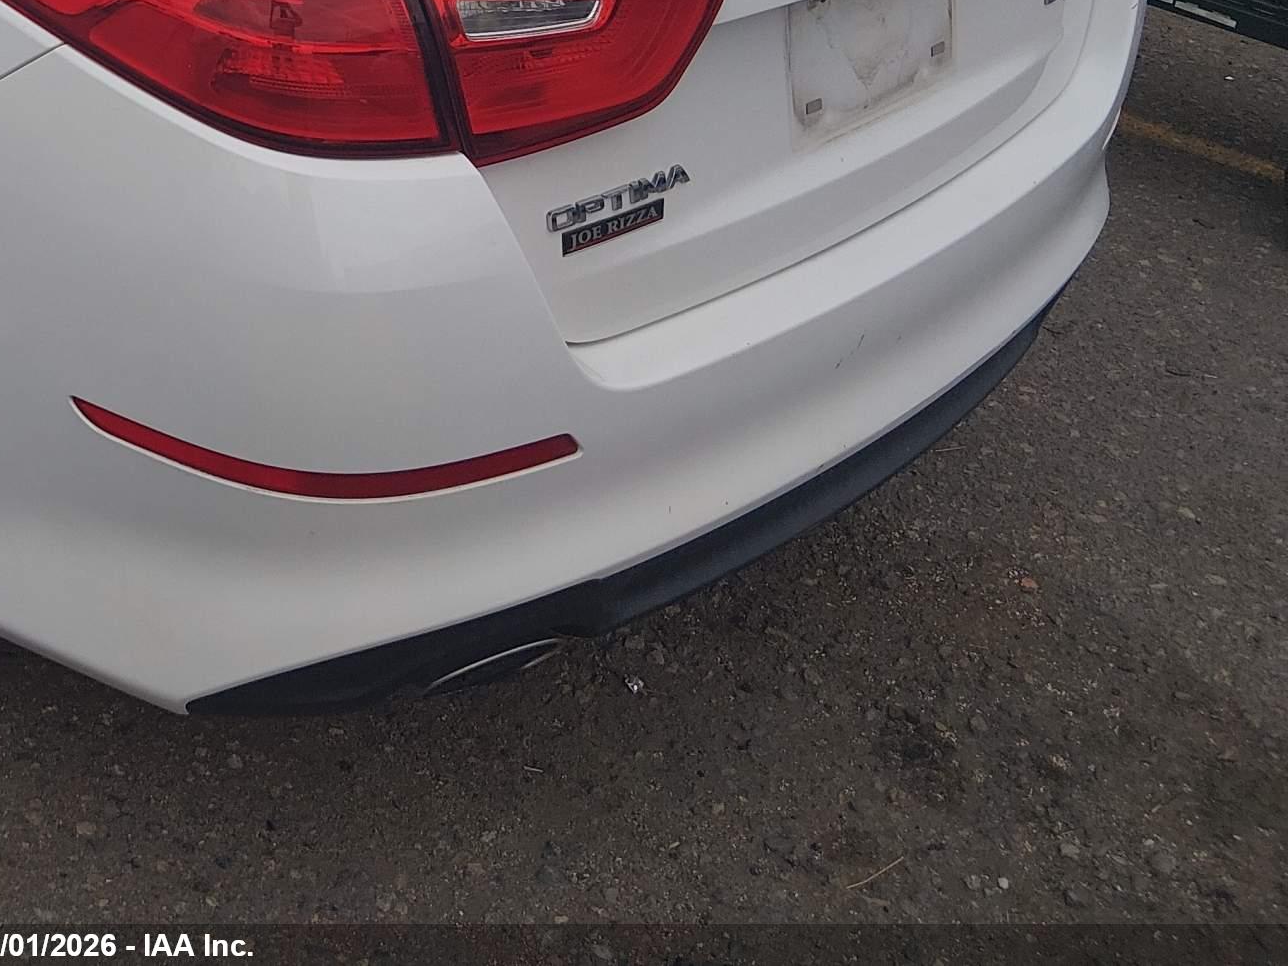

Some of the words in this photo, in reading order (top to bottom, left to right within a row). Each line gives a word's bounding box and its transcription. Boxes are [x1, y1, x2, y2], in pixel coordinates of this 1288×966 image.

[546, 163, 691, 233] OPTIMA
[567, 225, 603, 251] JOE
[607, 205, 659, 235] RIZZA
